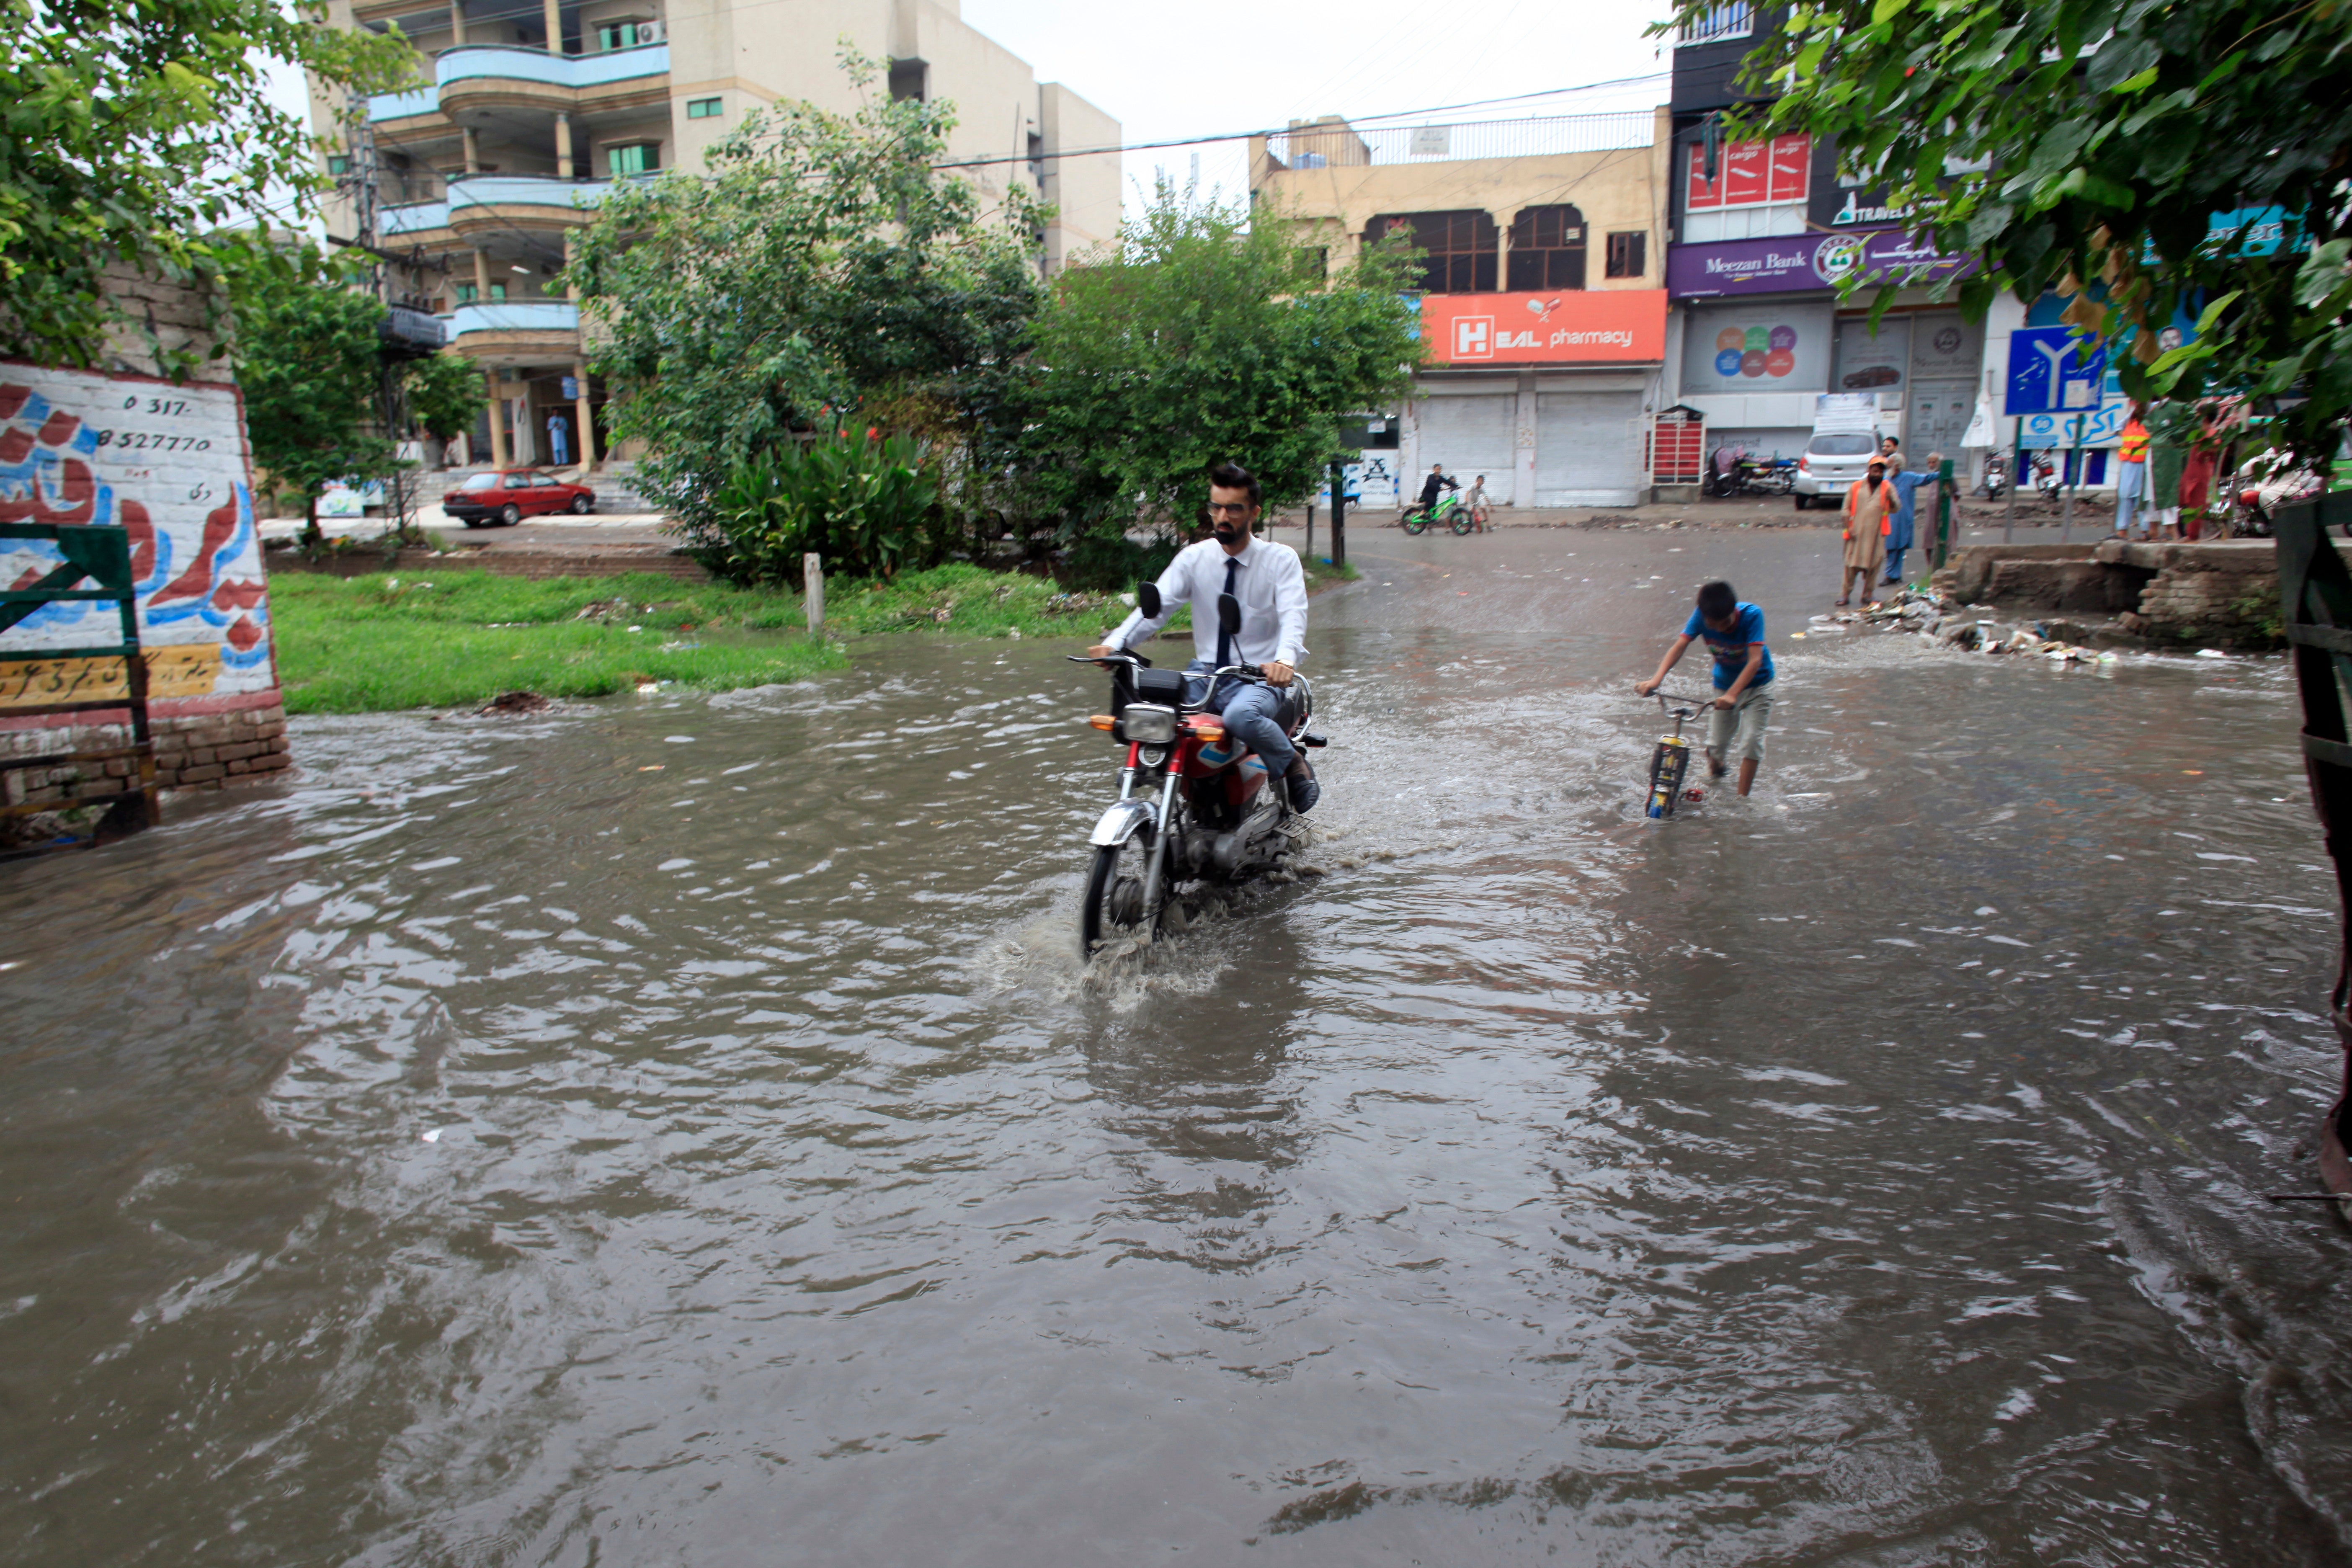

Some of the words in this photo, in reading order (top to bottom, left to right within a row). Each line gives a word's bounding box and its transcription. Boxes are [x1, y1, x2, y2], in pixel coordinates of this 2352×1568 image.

[1857, 206, 1906, 222] TRAVEL
[1705, 258, 1762, 274] Meezan
[1765, 251, 1808, 269] Bank
[1458, 322, 1543, 353] HEAL
[1550, 328, 1632, 348] pharmacy
